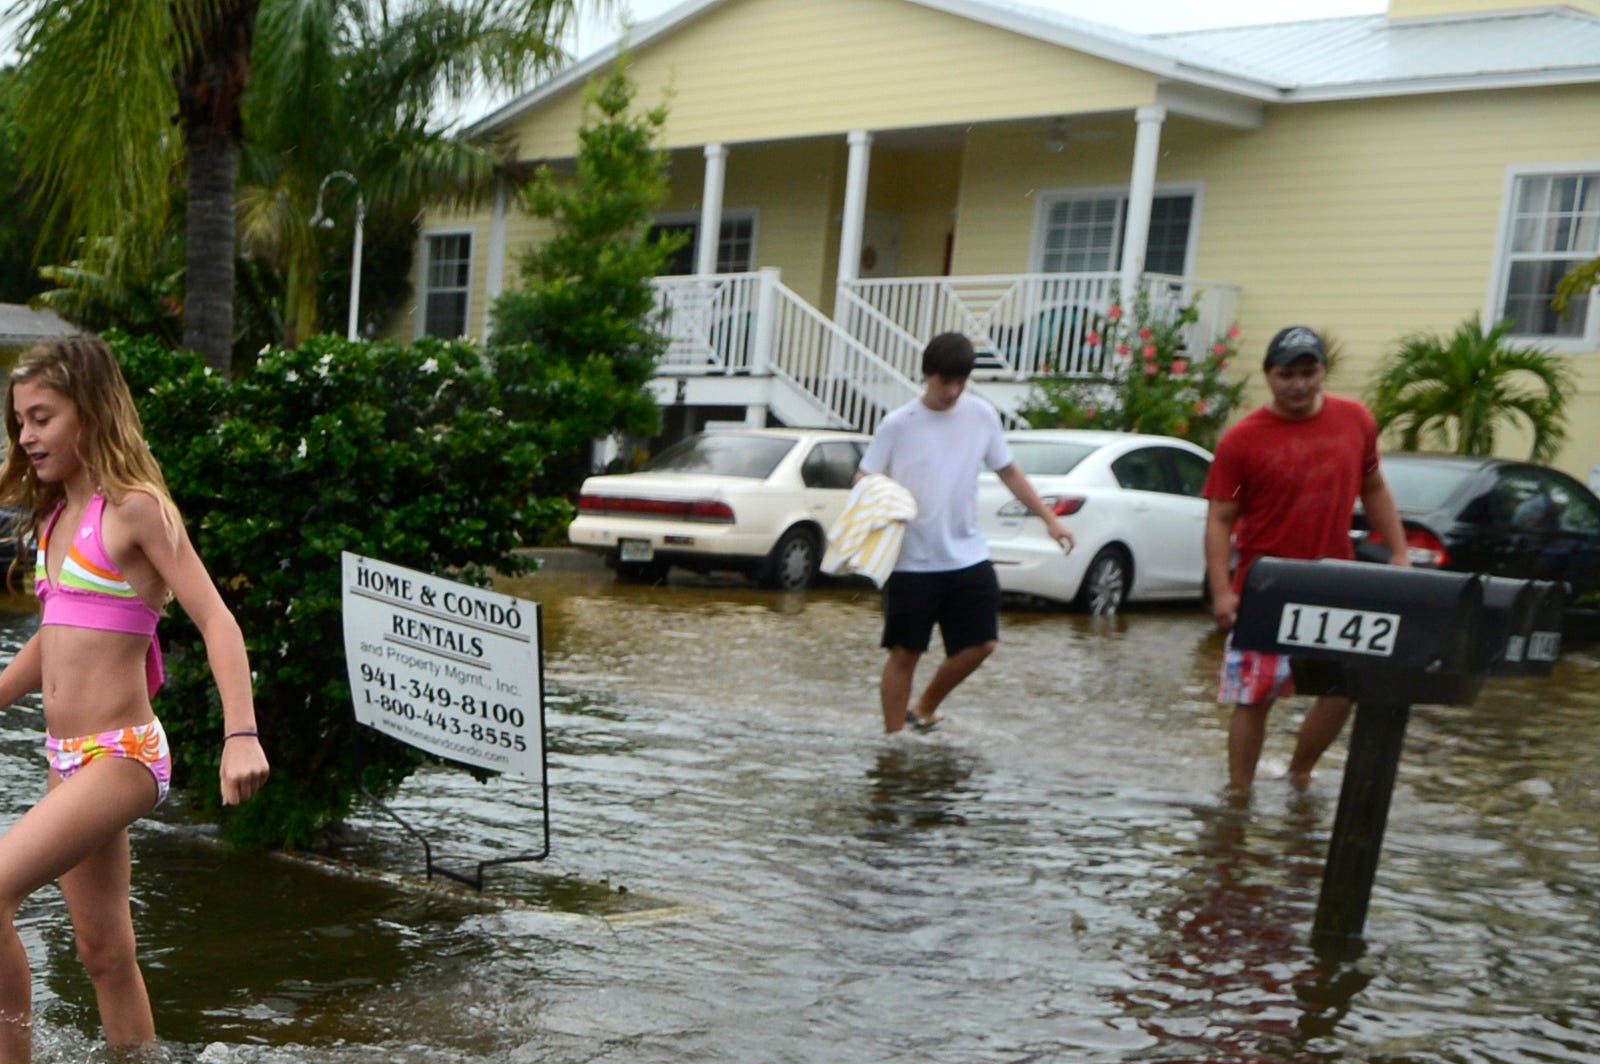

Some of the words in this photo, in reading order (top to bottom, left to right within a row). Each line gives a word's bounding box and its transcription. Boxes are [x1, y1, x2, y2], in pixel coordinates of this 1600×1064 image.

[357, 566, 413, 601] HOME
[420, 585, 437, 607] &
[443, 592, 522, 629] CONDO
[392, 614, 484, 658] RENTALS
[1286, 608, 1392, 651] 1142
[360, 641, 383, 657] and
[386, 647, 442, 677] Property
[496, 678, 522, 697] Inc.
[360, 663, 525, 728] 941-349-8100
[365, 689, 527, 752] 1-800-443-8555
